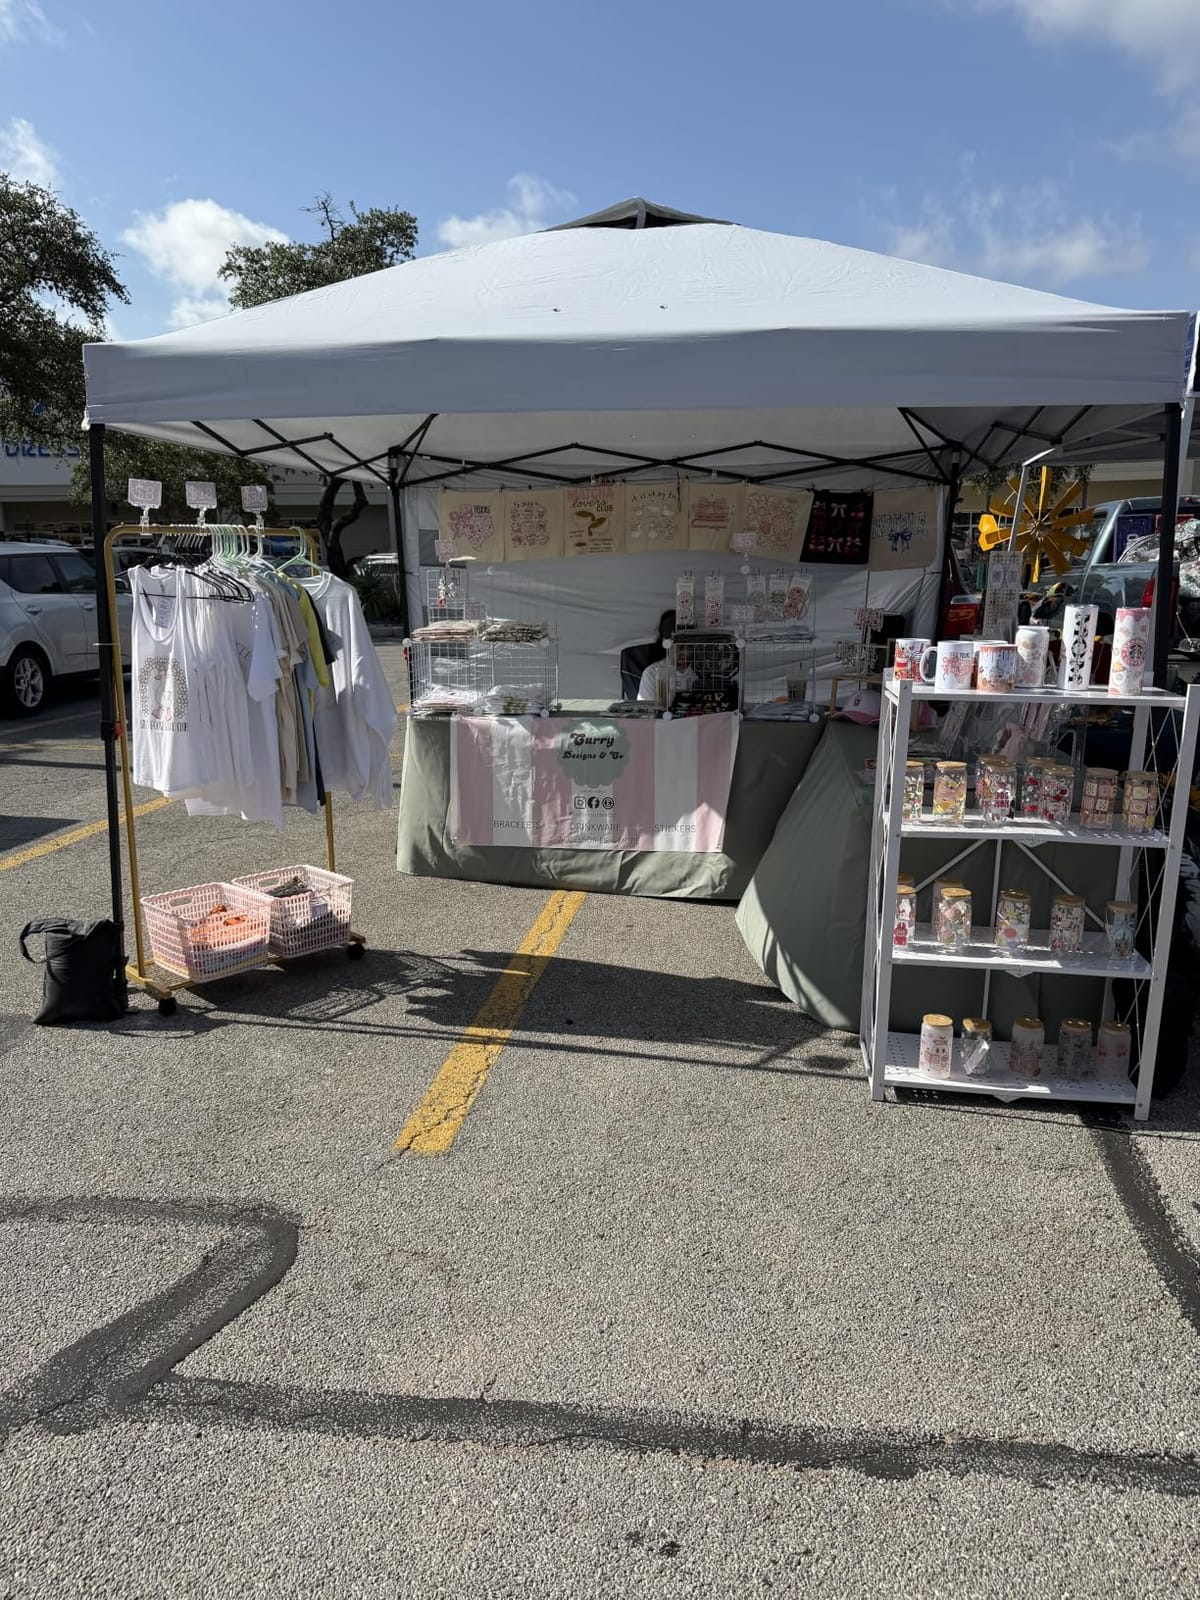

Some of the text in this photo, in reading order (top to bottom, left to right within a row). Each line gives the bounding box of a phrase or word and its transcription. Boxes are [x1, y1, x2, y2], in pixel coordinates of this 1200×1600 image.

[5, 439, 80, 457] DRES
[570, 733, 615, 747] Curry
[562, 751, 597, 761] Designs
[609, 751, 624, 760] Co
[654, 823, 697, 833] STICKERS
